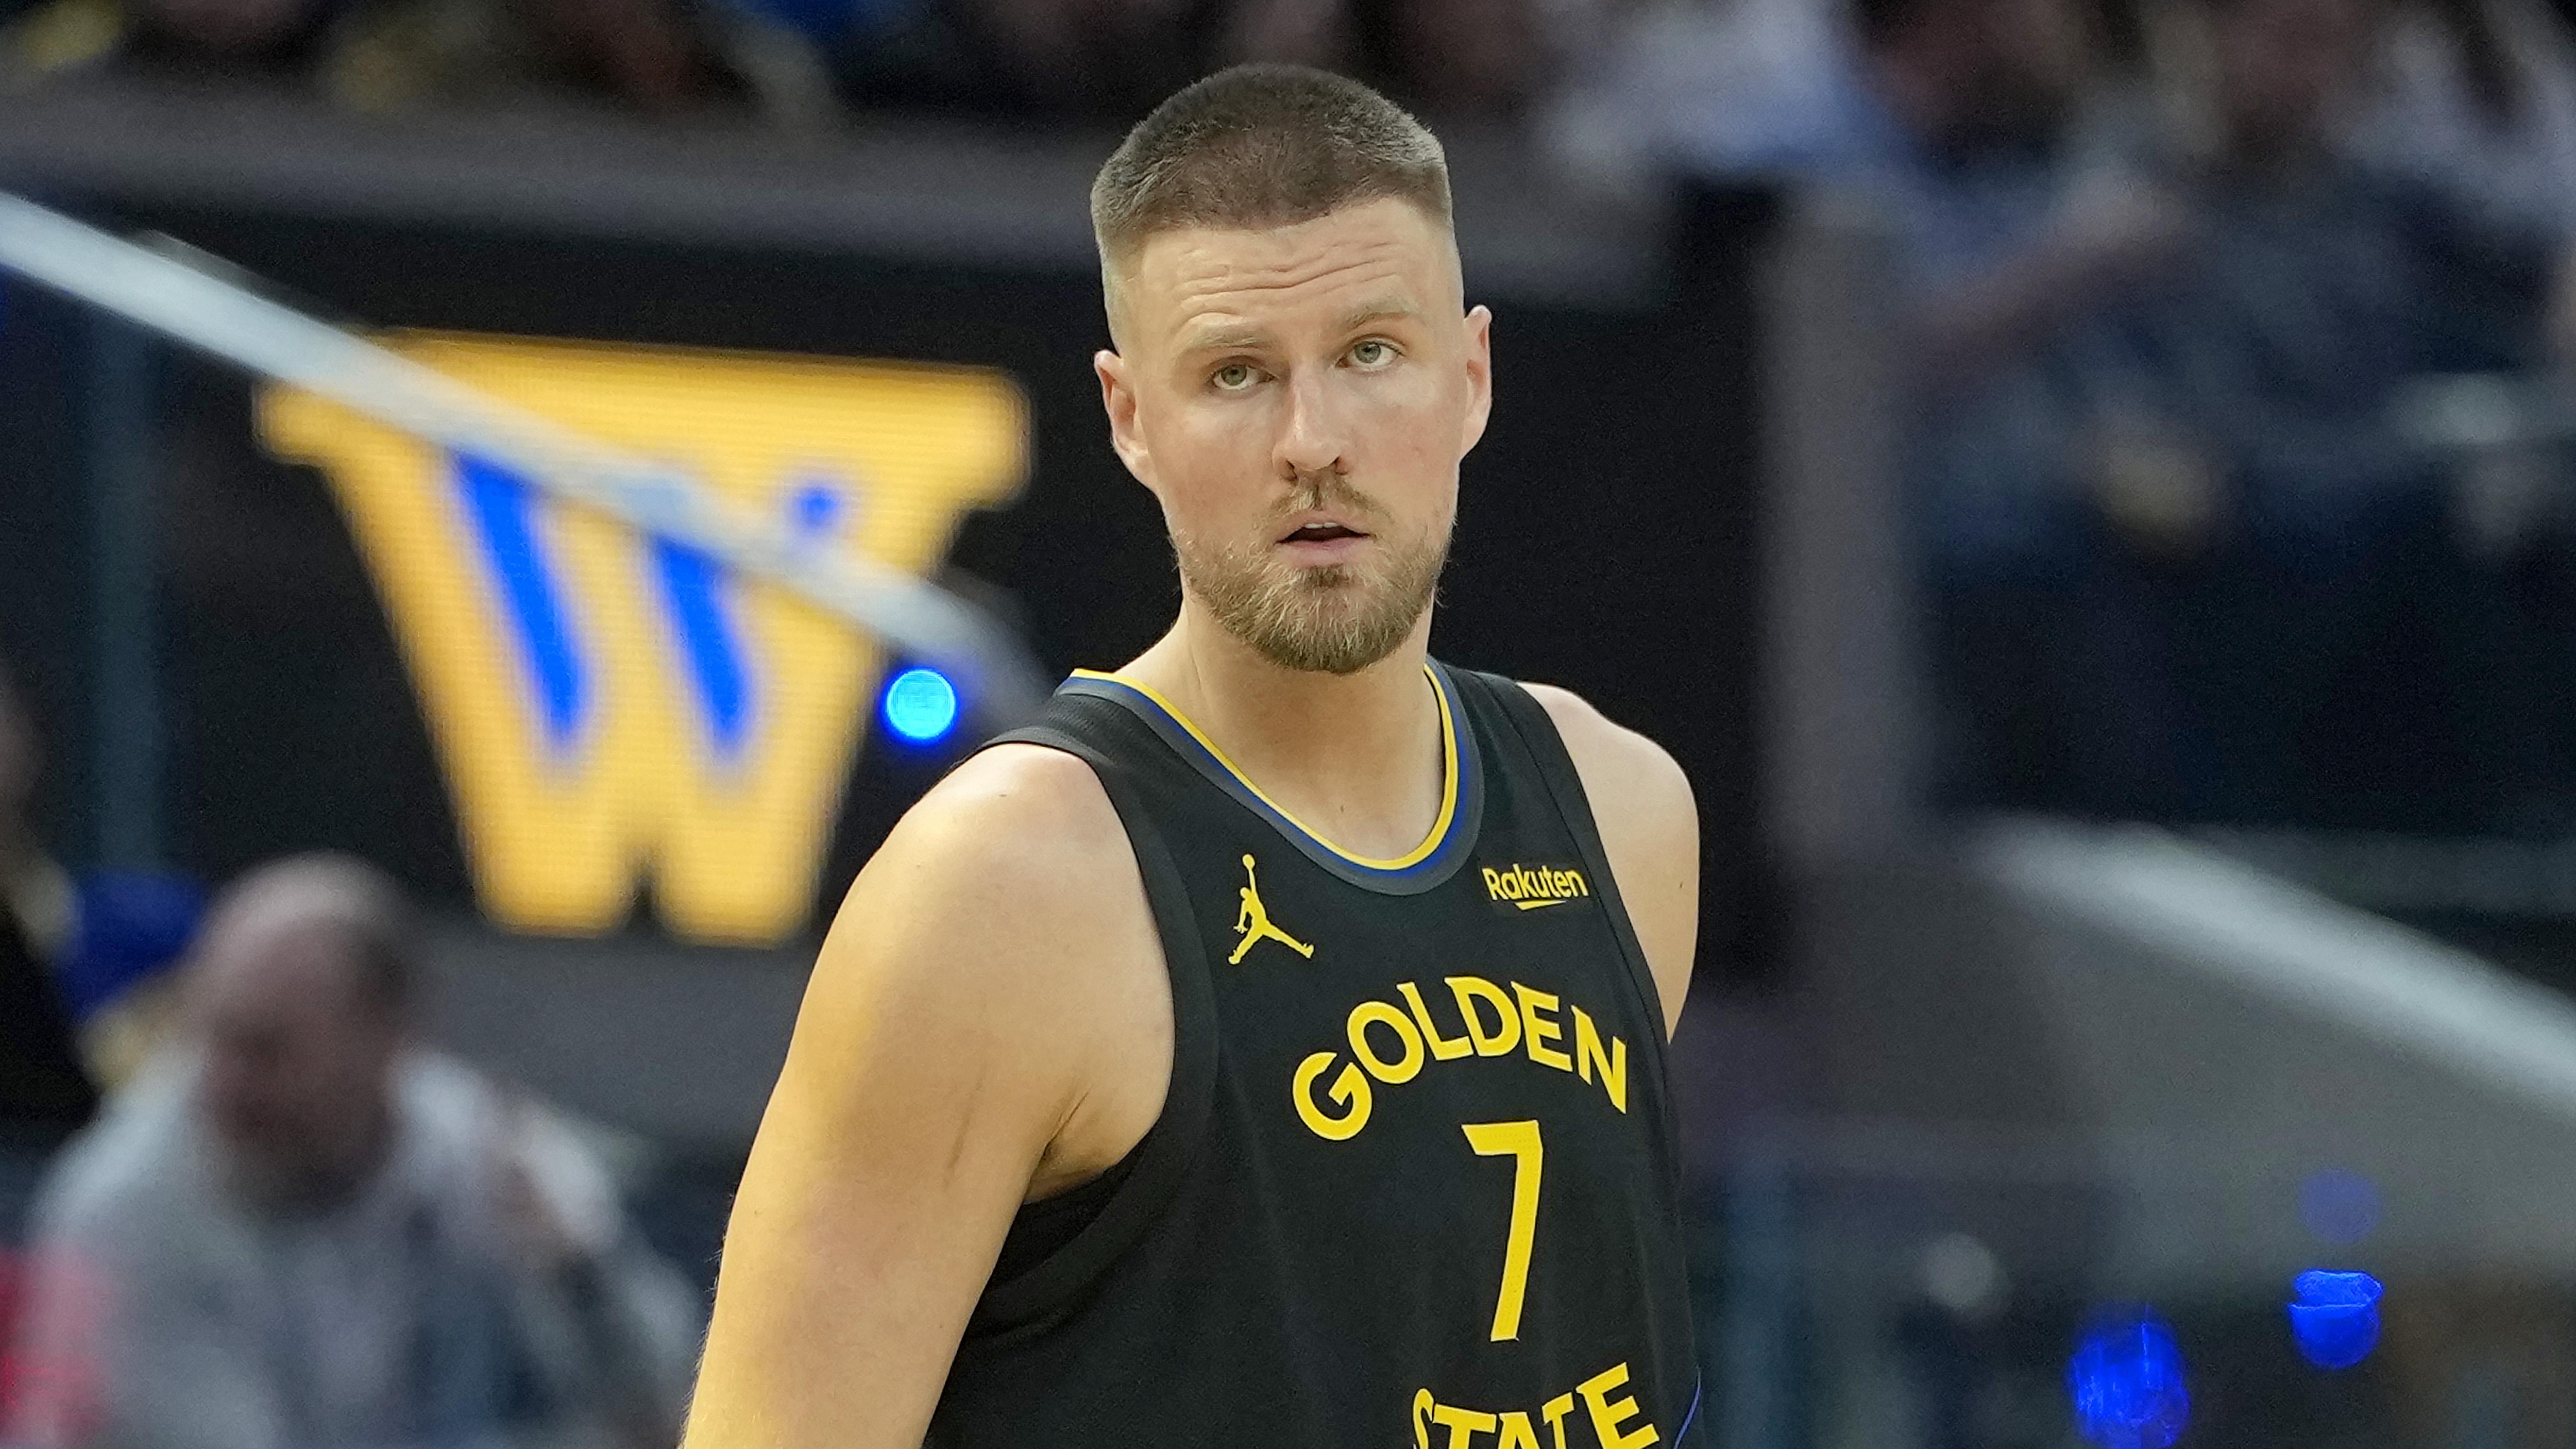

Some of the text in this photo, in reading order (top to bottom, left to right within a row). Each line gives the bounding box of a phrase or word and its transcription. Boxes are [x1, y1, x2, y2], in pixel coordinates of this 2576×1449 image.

[1482, 863, 1589, 900] Rakuten
[1292, 976, 1627, 1140] GOLDEN
[1462, 1120, 1544, 1341] 7
